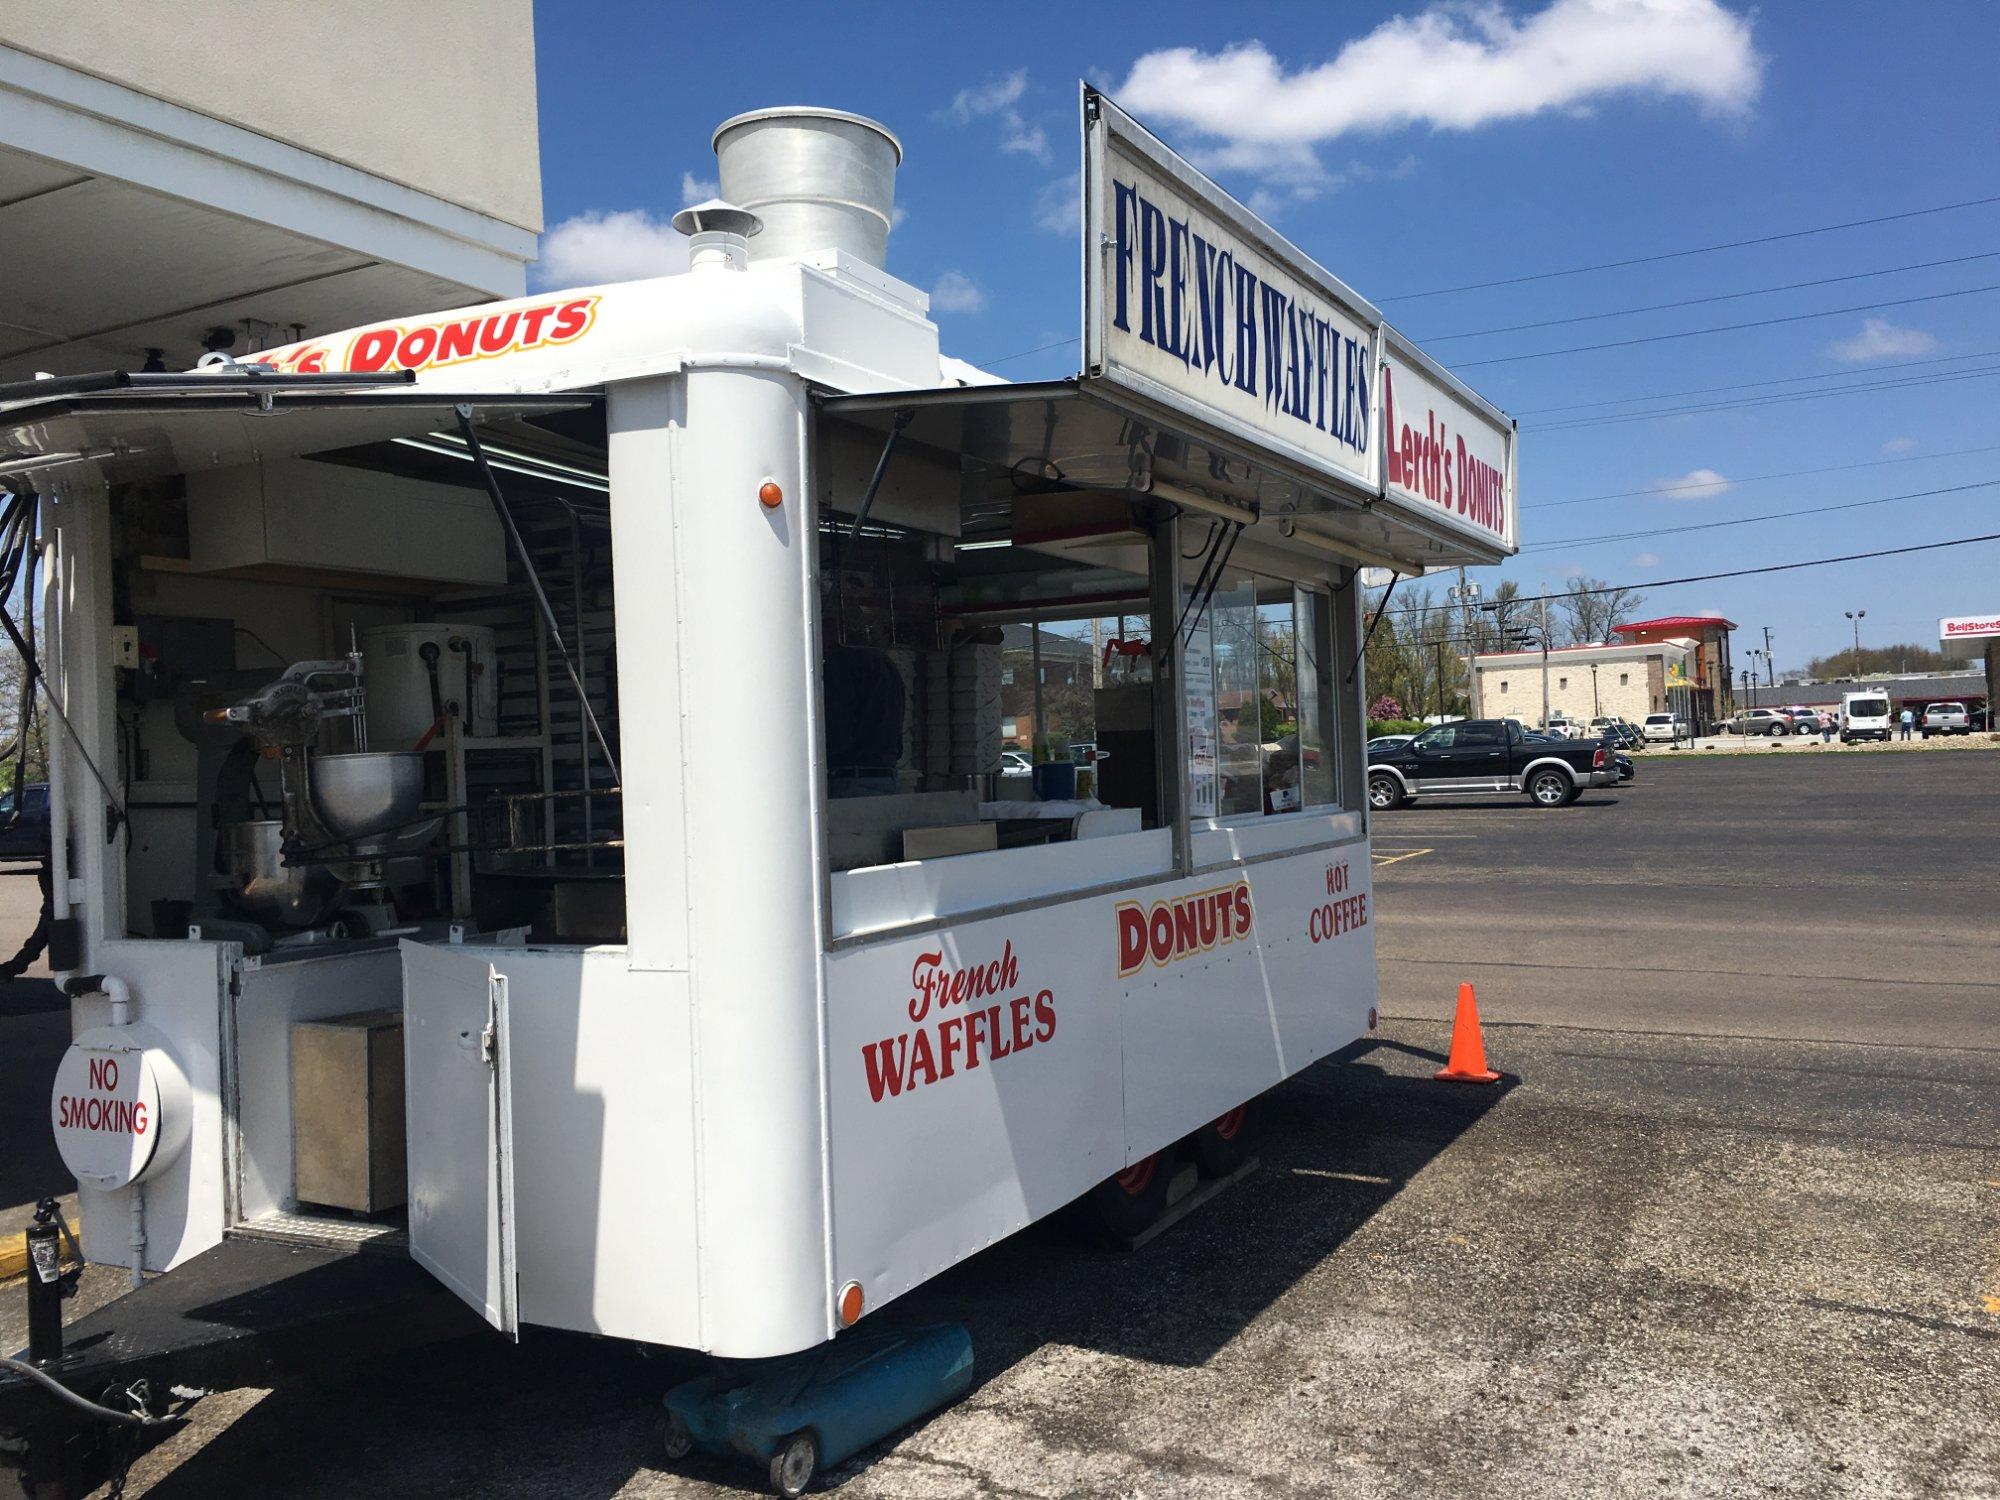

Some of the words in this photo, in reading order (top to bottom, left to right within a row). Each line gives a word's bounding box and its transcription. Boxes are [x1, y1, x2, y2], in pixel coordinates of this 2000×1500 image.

[347, 298, 598, 374] DONUTS
[1113, 179, 1257, 397] FRENCH
[1260, 281, 1370, 454] WAFFLES
[1386, 367, 1453, 510] Lerch's
[1456, 433, 1505, 536] DONUTS
[1310, 893, 1367, 944] COFFEE
[1326, 864, 1348, 895] HOT
[1117, 884, 1252, 976] DONUTS
[909, 939, 1019, 1022] French
[89, 1058, 118, 1091] NO
[862, 990, 1056, 1102] WAFFLES
[59, 1096, 148, 1135] SMOKING
